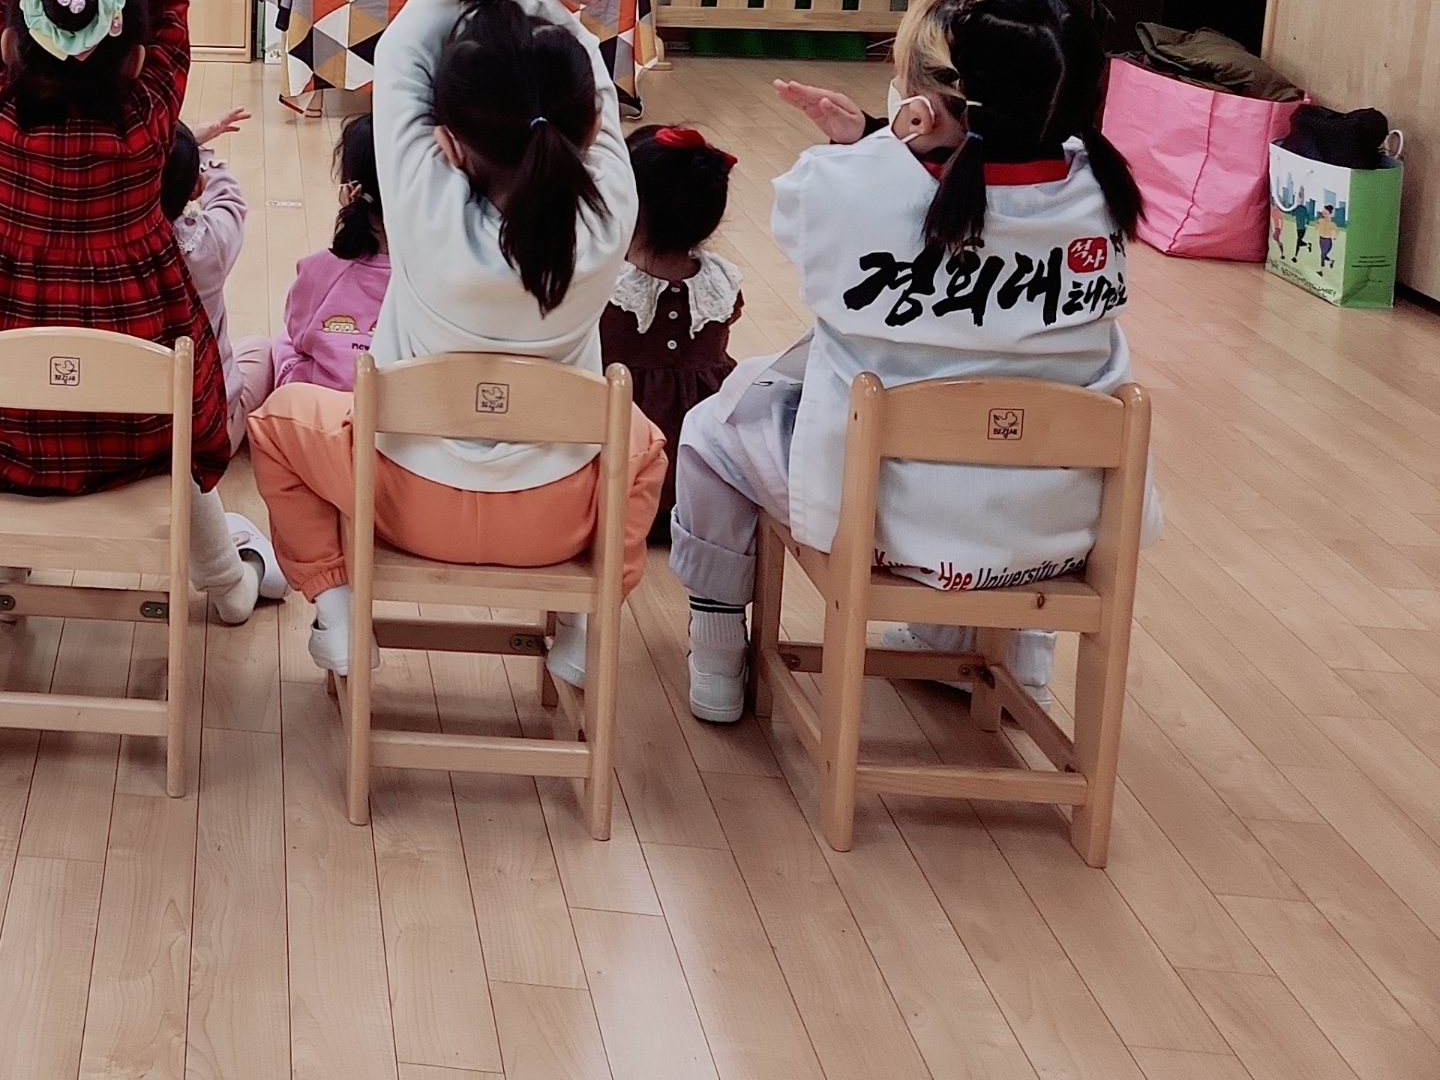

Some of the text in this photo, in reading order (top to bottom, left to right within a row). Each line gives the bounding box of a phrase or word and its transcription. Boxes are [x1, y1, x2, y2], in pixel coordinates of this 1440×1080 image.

[1070, 239, 1106, 269] 석사
[842, 234, 1064, 327] 경희대
[937, 561, 973, 590] Hee
